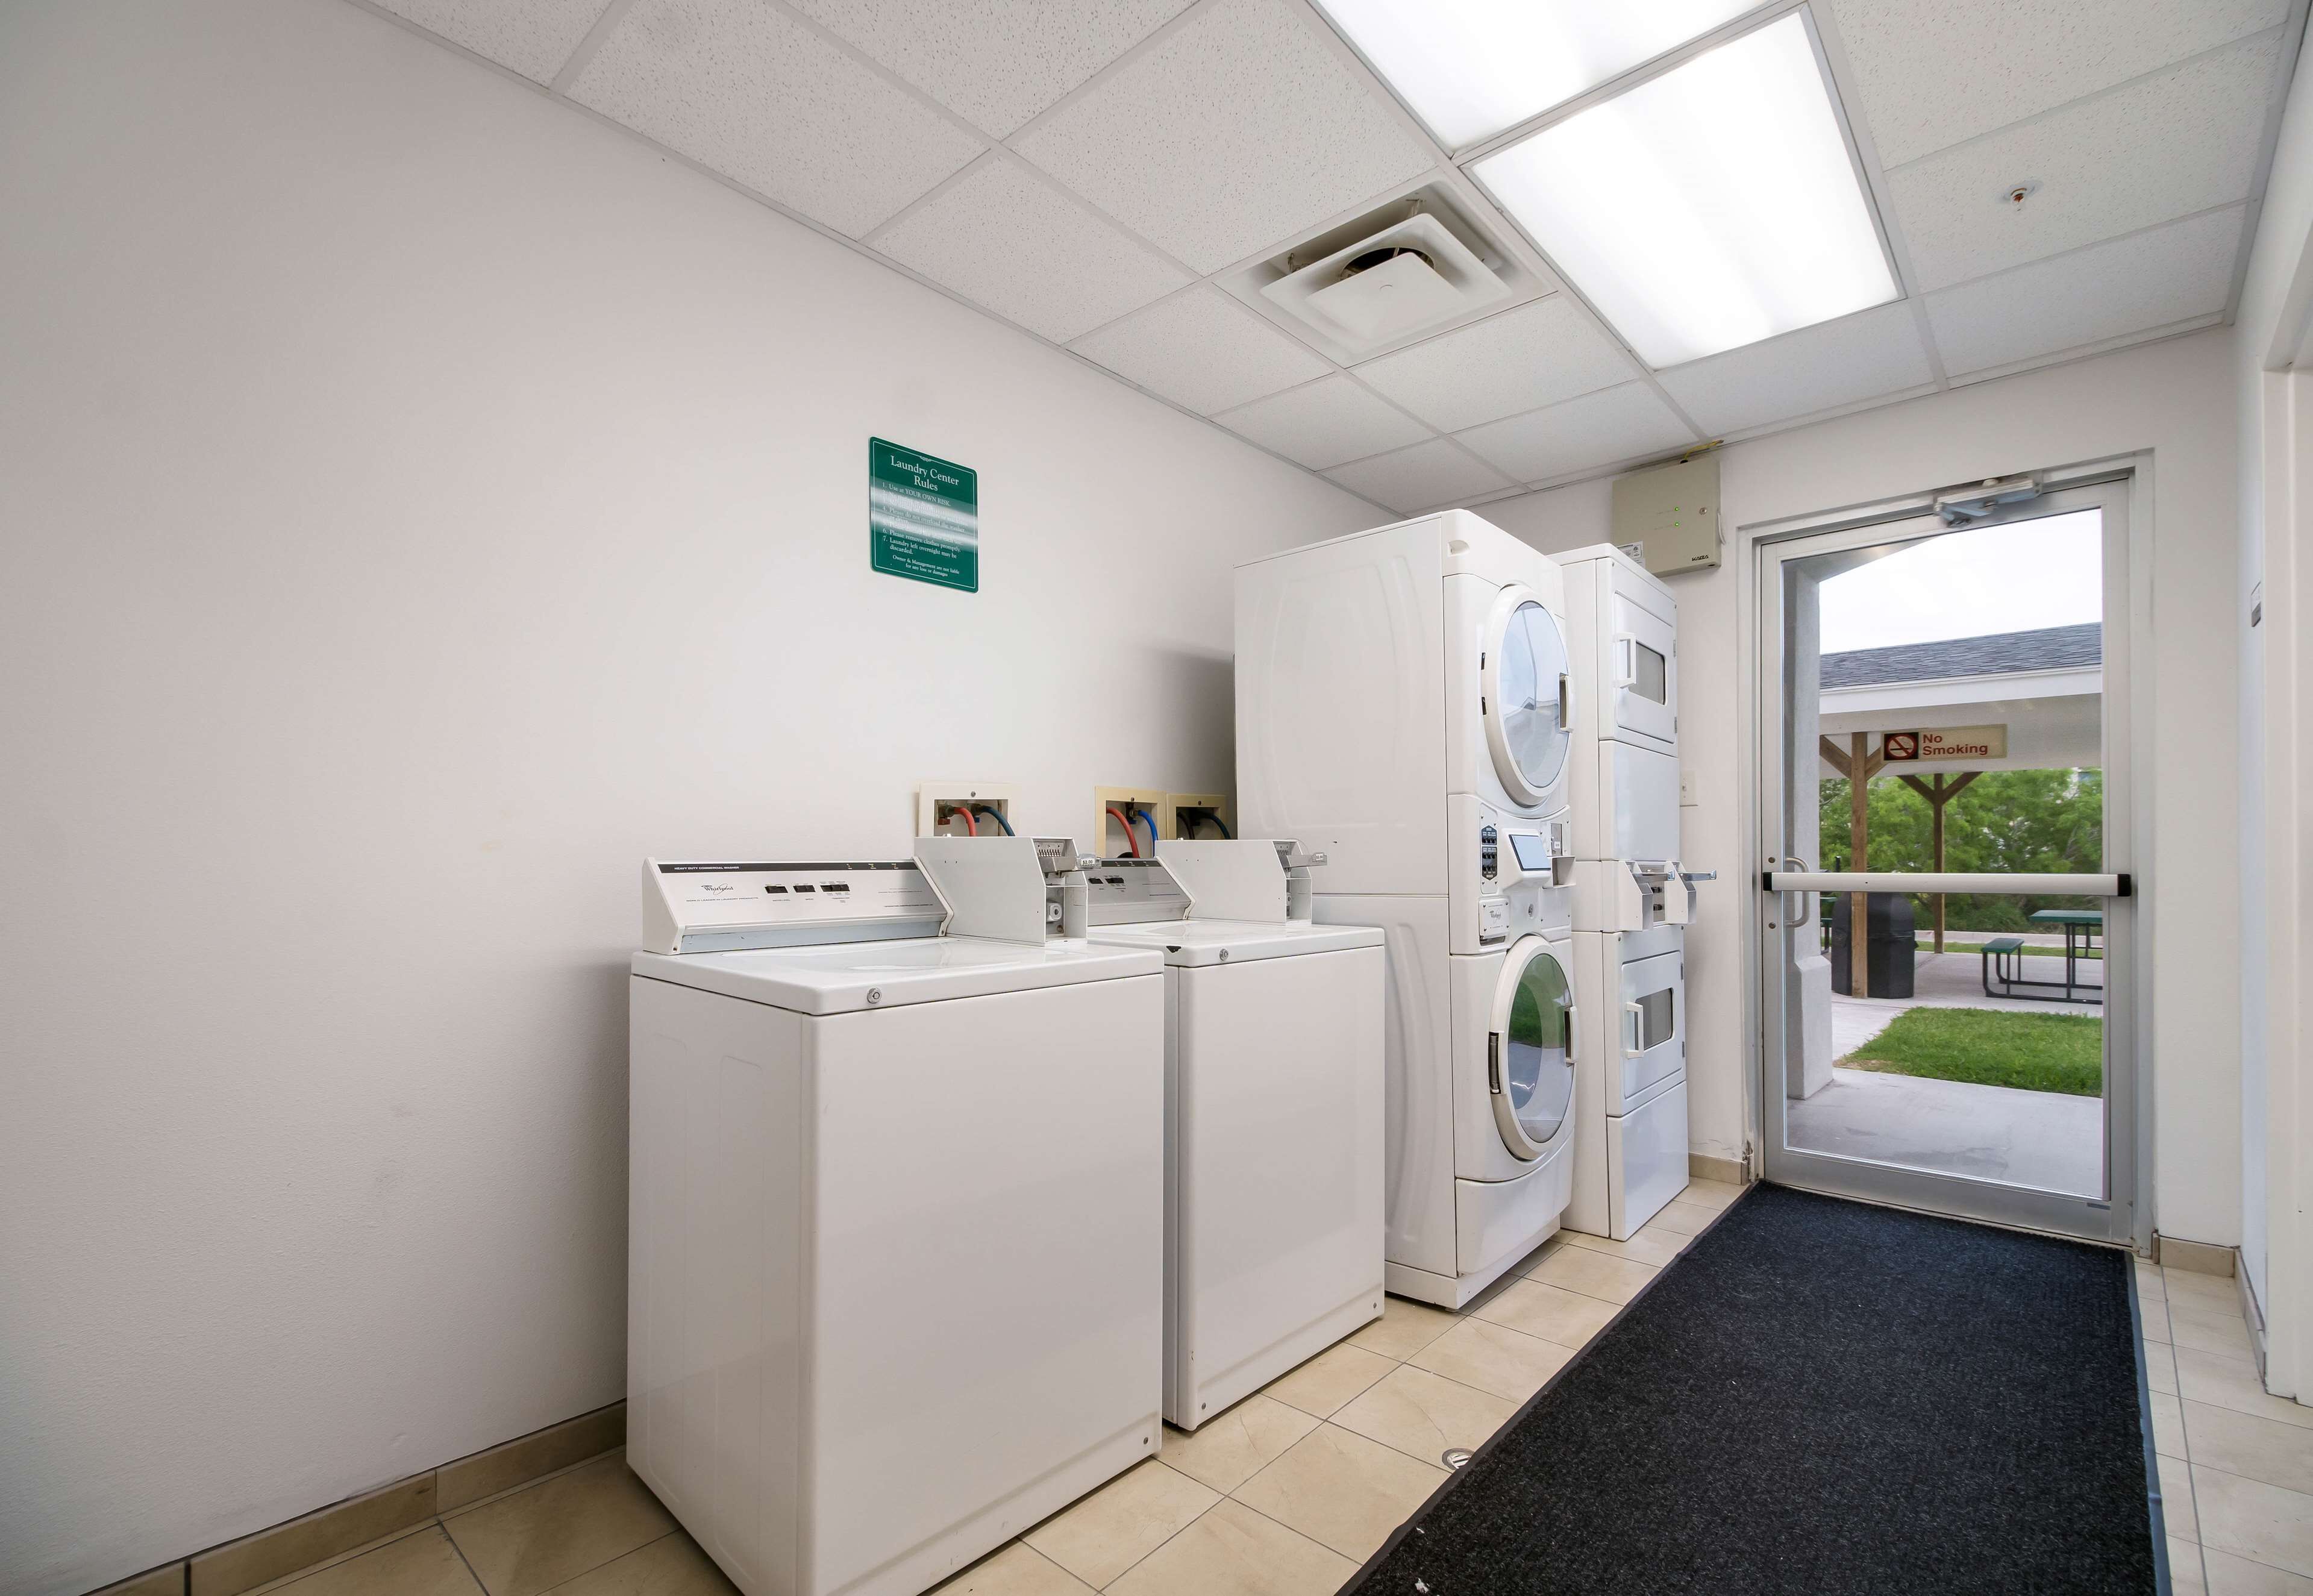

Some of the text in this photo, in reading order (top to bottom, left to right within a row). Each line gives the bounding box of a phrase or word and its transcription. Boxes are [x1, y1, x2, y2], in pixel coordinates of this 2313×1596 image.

[890, 455, 959, 486] Laundry Center
[914, 475, 938, 492] Rules
[906, 489, 921, 498] YOUR
[922, 493, 937, 502] OWN
[890, 530, 904, 538] Please
[924, 539, 939, 548] clothes
[941, 543, 961, 553] promptly.
[890, 537, 909, 548] Laundry
[919, 546, 940, 555] overnight
[890, 544, 913, 554] discarded.
[912, 559, 936, 569] Management
[1923, 734, 1942, 743] No
[1923, 744, 1988, 756] Smoking
[704, 884, 733, 894] Whirlpool
